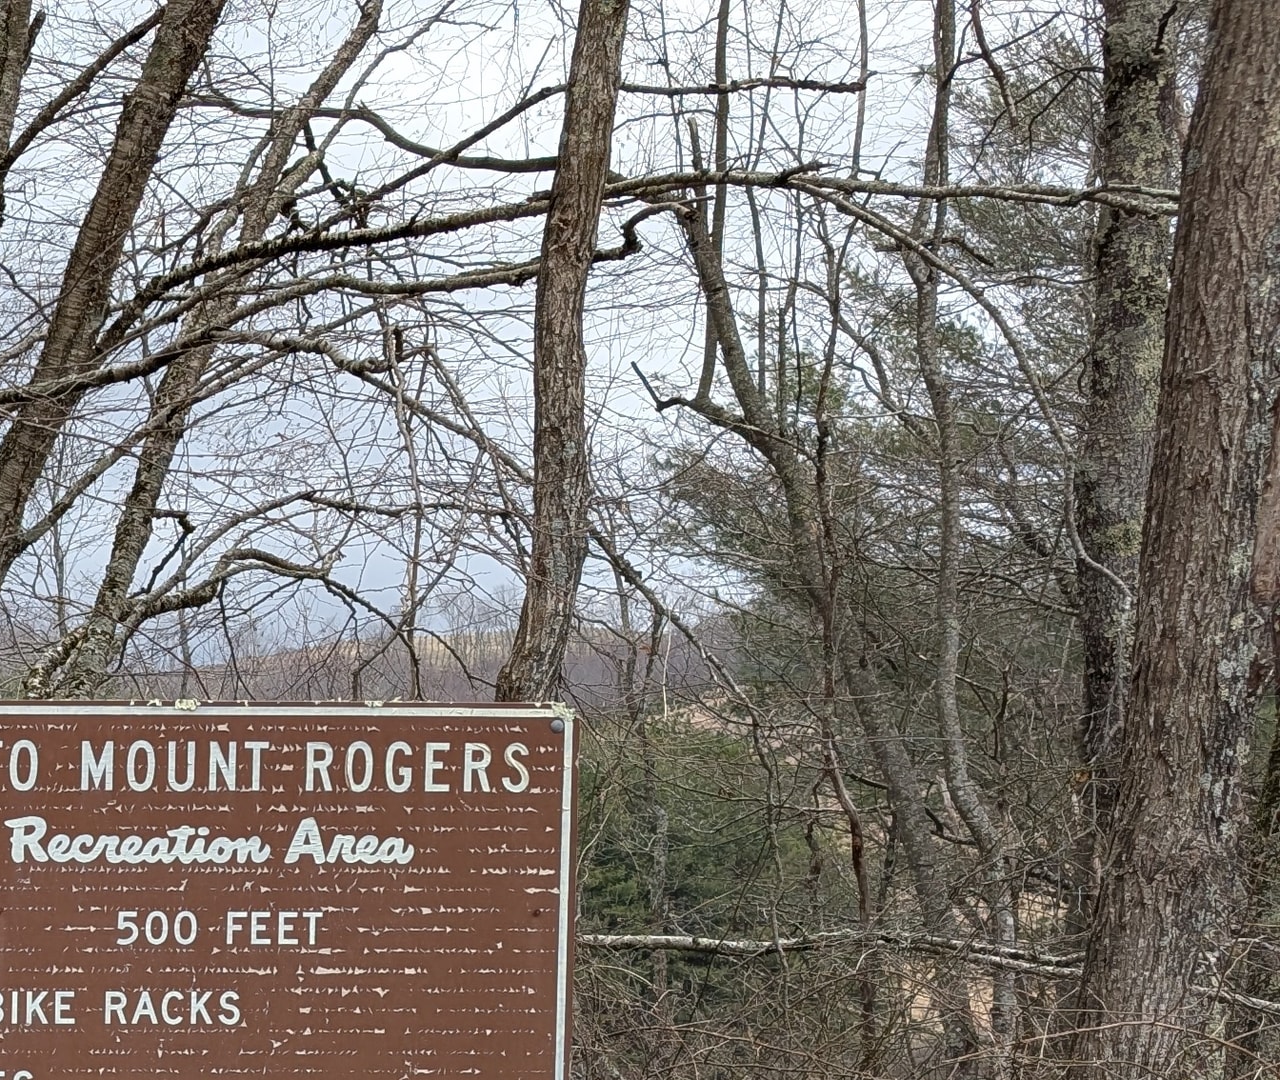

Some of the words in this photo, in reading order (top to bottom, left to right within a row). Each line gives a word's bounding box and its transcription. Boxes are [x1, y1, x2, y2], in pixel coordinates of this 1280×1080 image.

[80, 739, 270, 793] MOUNT
[305, 740, 531, 794] ROGERS
[3, 815, 274, 864] Recreation
[283, 815, 415, 865] Area
[116, 910, 198, 946] 500
[226, 911, 325, 946] FEET
[104, 989, 241, 1026] RACKS
